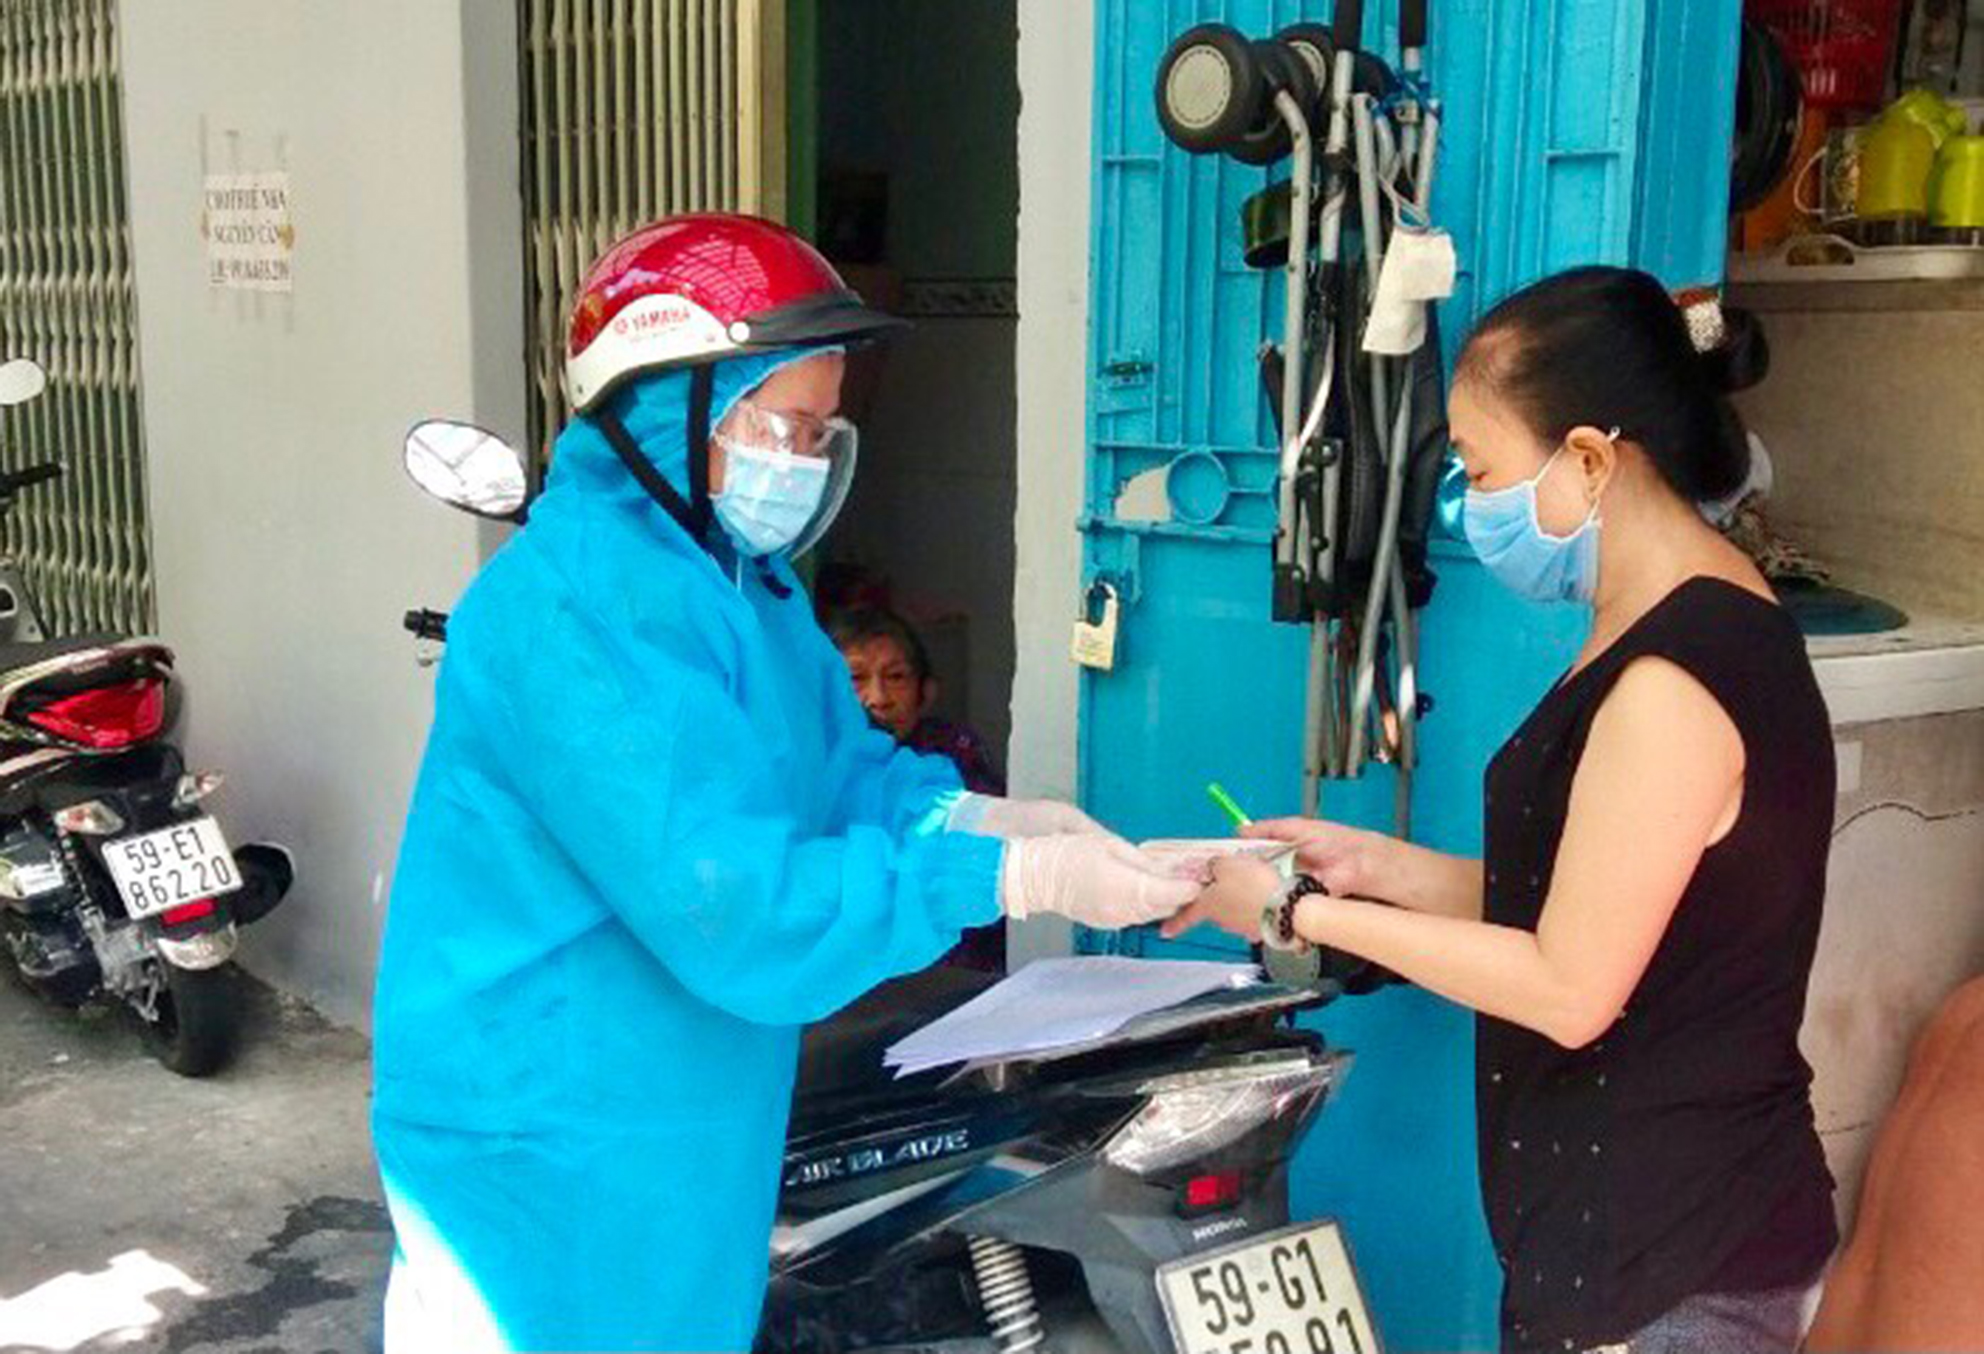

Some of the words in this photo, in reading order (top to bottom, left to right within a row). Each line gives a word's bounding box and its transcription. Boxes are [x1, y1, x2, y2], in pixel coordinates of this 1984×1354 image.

[123, 826, 205, 875] 59-E1
[129, 855, 232, 911] 862.20
[1190, 1237, 1328, 1336] 59-G1
